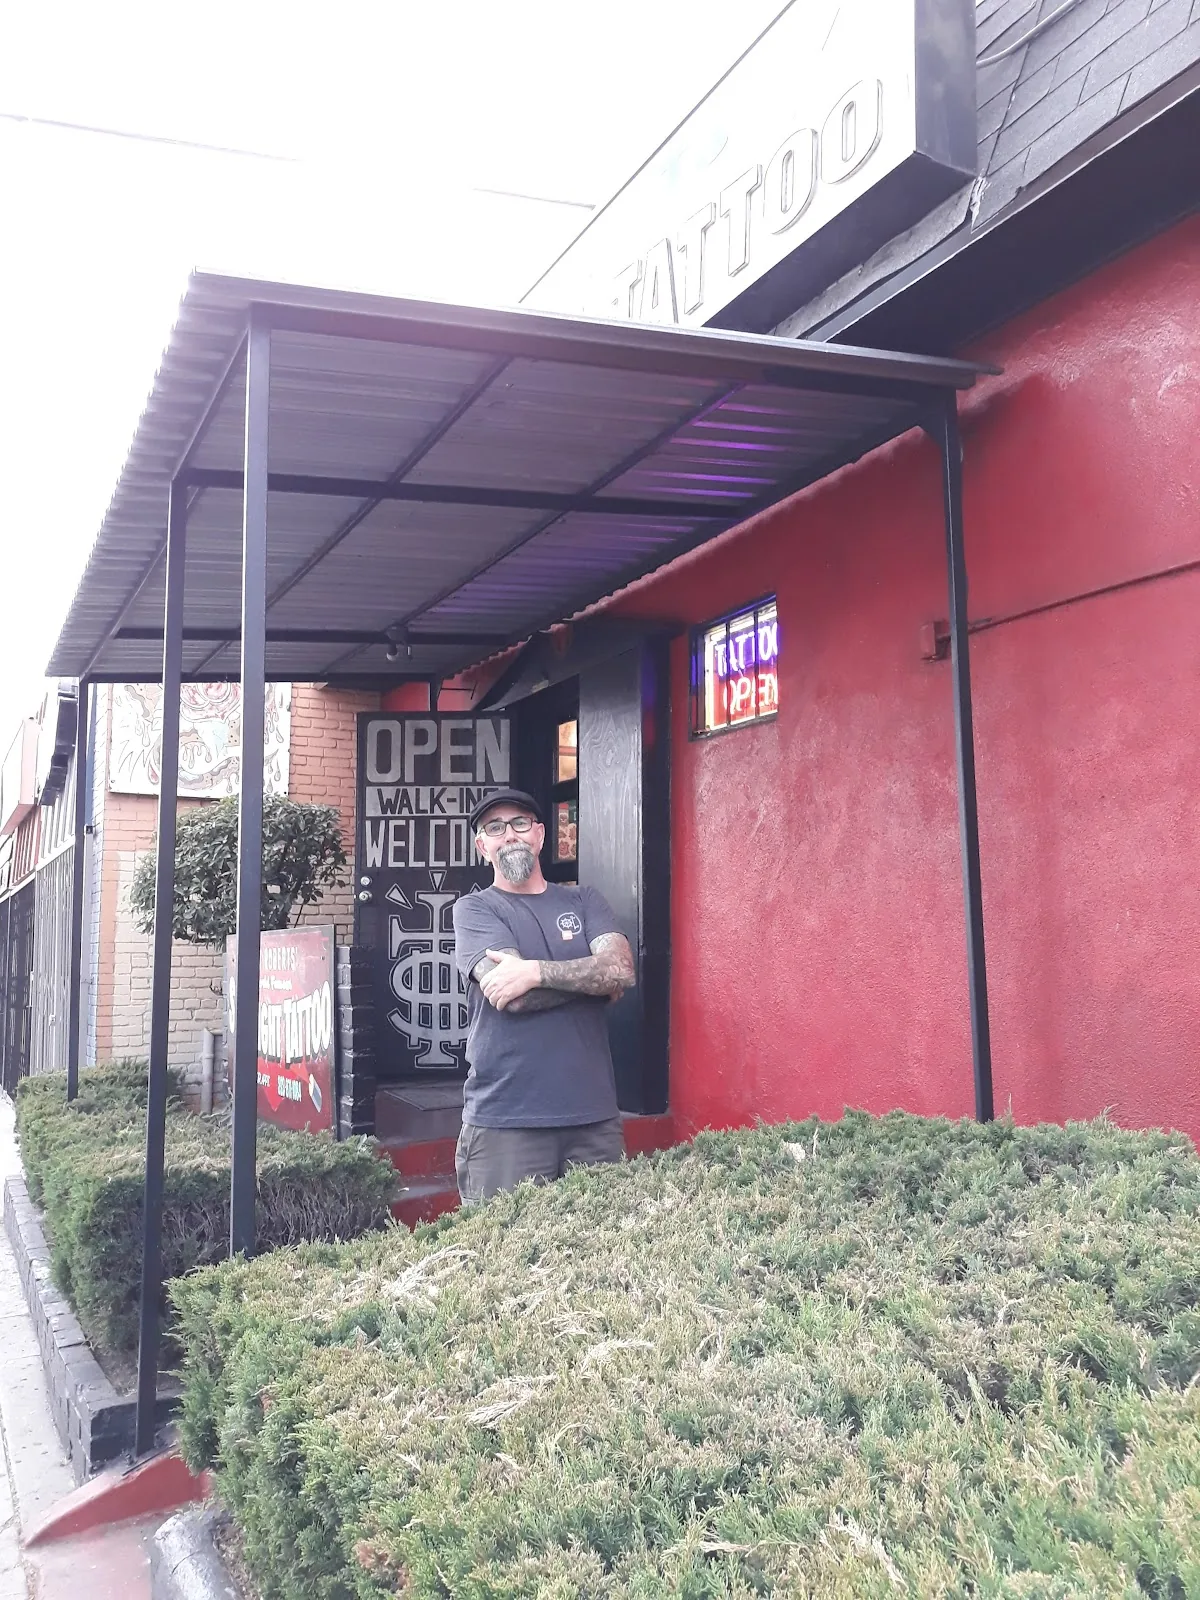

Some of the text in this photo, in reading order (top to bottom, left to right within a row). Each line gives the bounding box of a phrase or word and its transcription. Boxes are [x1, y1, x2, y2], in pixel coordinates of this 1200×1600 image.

[609, 78, 883, 324] TATTOO
[366, 719, 510, 783] OPEN
[365, 818, 492, 868] WELCOM
[283, 980, 331, 1064] TATTOO
